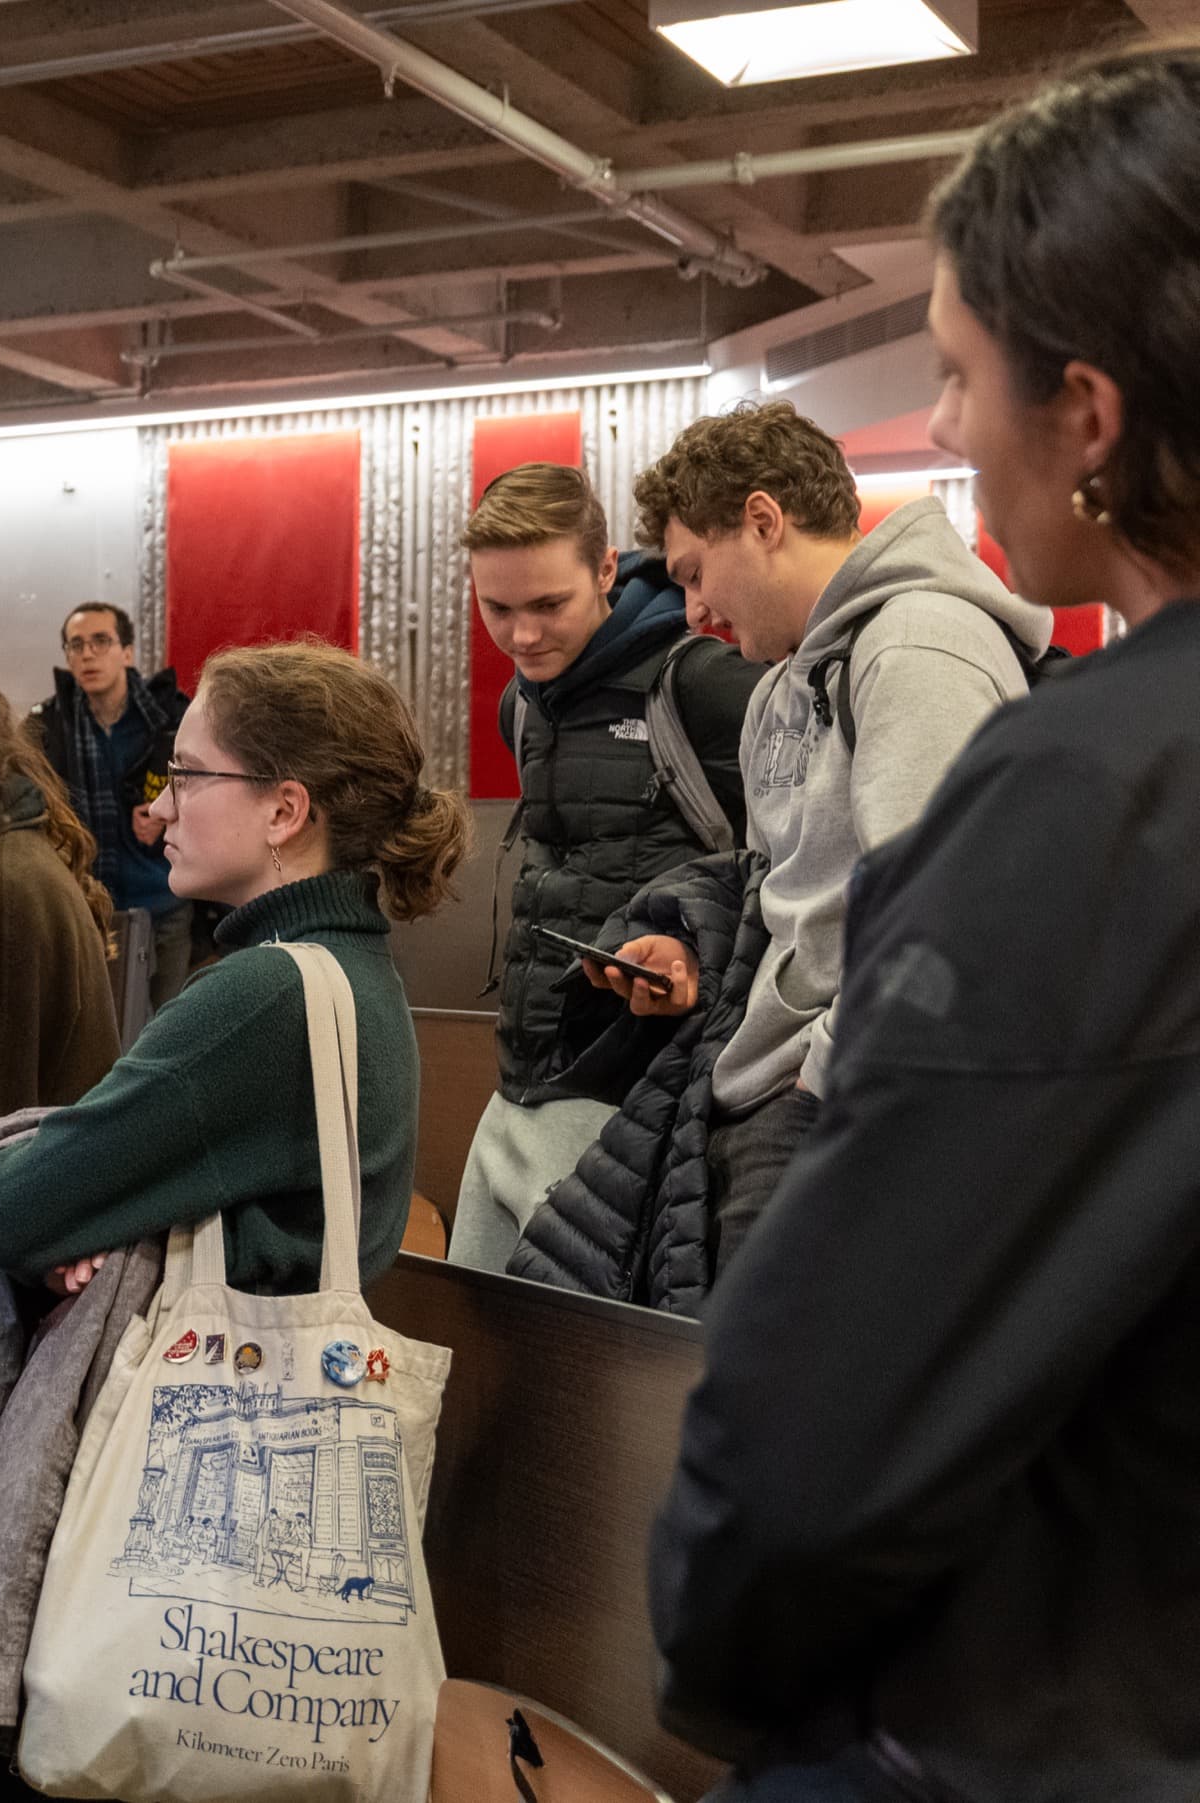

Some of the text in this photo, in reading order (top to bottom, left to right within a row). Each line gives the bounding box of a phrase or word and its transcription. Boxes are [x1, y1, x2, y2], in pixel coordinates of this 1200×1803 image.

[608, 724, 637, 733] NORTH
[614, 731, 637, 740] FACE
[300, 1425, 322, 1437] BOOKS
[160, 1603, 384, 1689] Shakespeare
[128, 1657, 400, 1744] and Company
[176, 1728, 350, 1774] Kilometer Zero Paris
